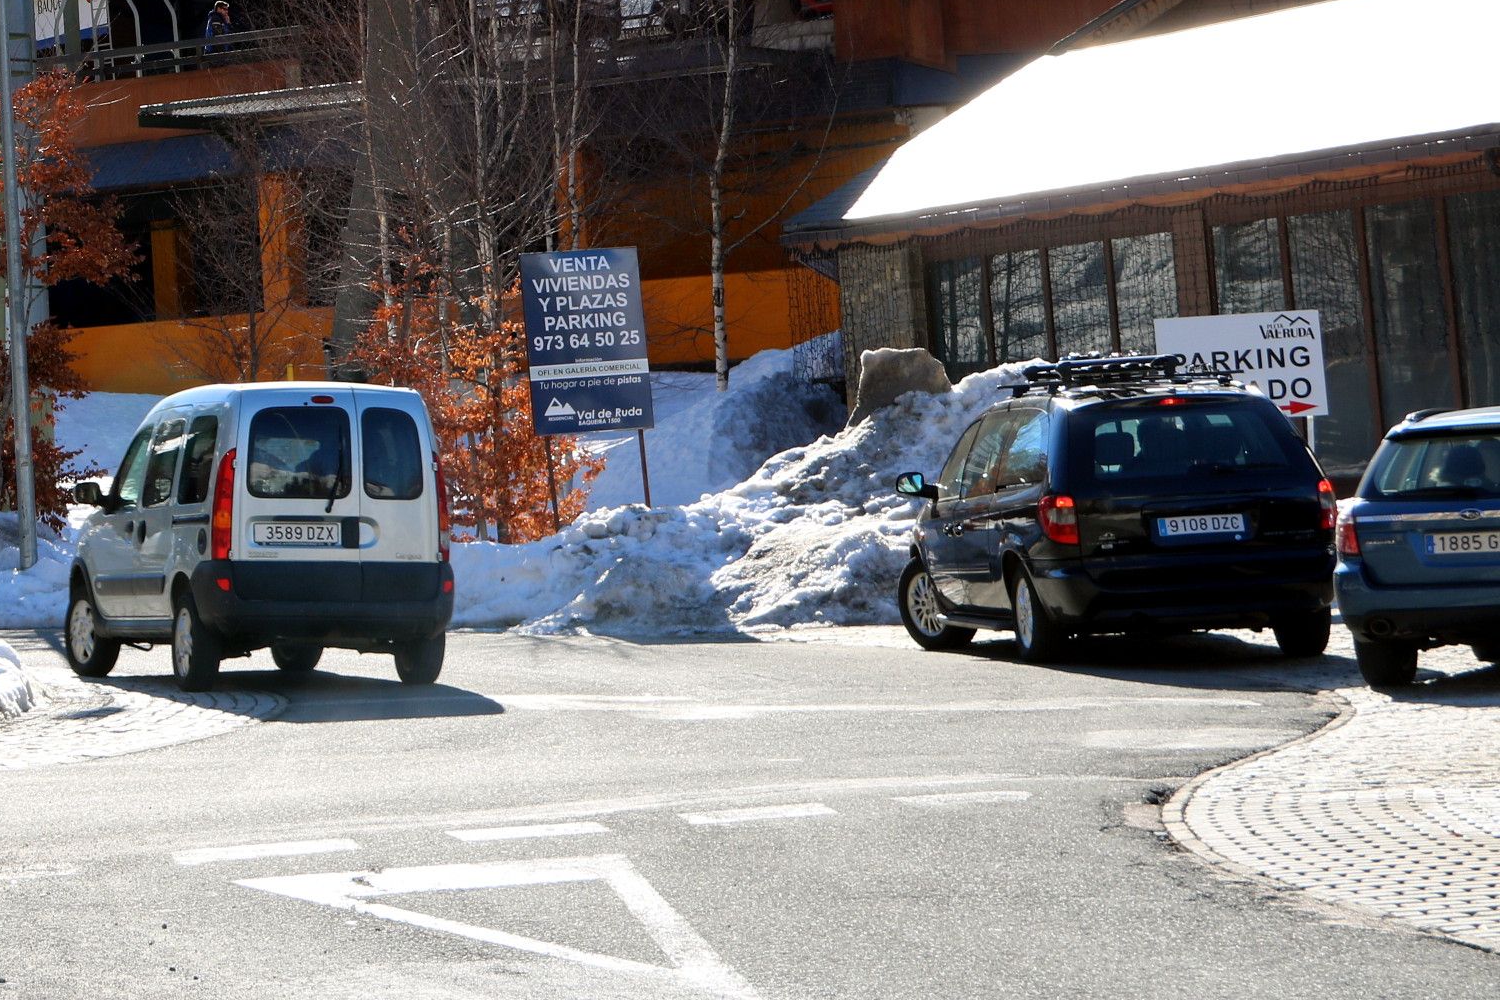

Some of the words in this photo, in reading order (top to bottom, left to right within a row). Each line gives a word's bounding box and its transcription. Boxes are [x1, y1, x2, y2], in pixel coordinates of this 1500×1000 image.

[549, 256, 610, 273] VENTA
[532, 273, 630, 294] VIVIENDAS
[538, 297, 550, 312] Y
[555, 292, 628, 312] PLAZAS
[544, 311, 626, 332] PARKING
[533, 335, 564, 351] 973
[569, 333, 590, 348] 64
[595, 331, 615, 347] 50
[619, 330, 640, 345] 25
[553, 368, 564, 376] EN
[565, 366, 597, 374] GALERÍA
[598, 362, 642, 372] COMERCIAL
[539, 381, 550, 390] Tu
[551, 379, 577, 390] hogar
[587, 378, 601, 388] pie
[603, 377, 615, 385] de
[617, 375, 642, 386] pistas
[576, 410, 595, 420] Val
[598, 408, 612, 418] de
[615, 406, 643, 417] Ruda
[578, 418, 607, 426] BAQUEIRA
[1168, 517, 1207, 532] 9108
[1212, 516, 1240, 530] DZC
[266, 526, 302, 540] 3589
[307, 526, 334, 540] DZX
[1439, 535, 1483, 551] 1885
[1488, 534, 1499, 549] G
